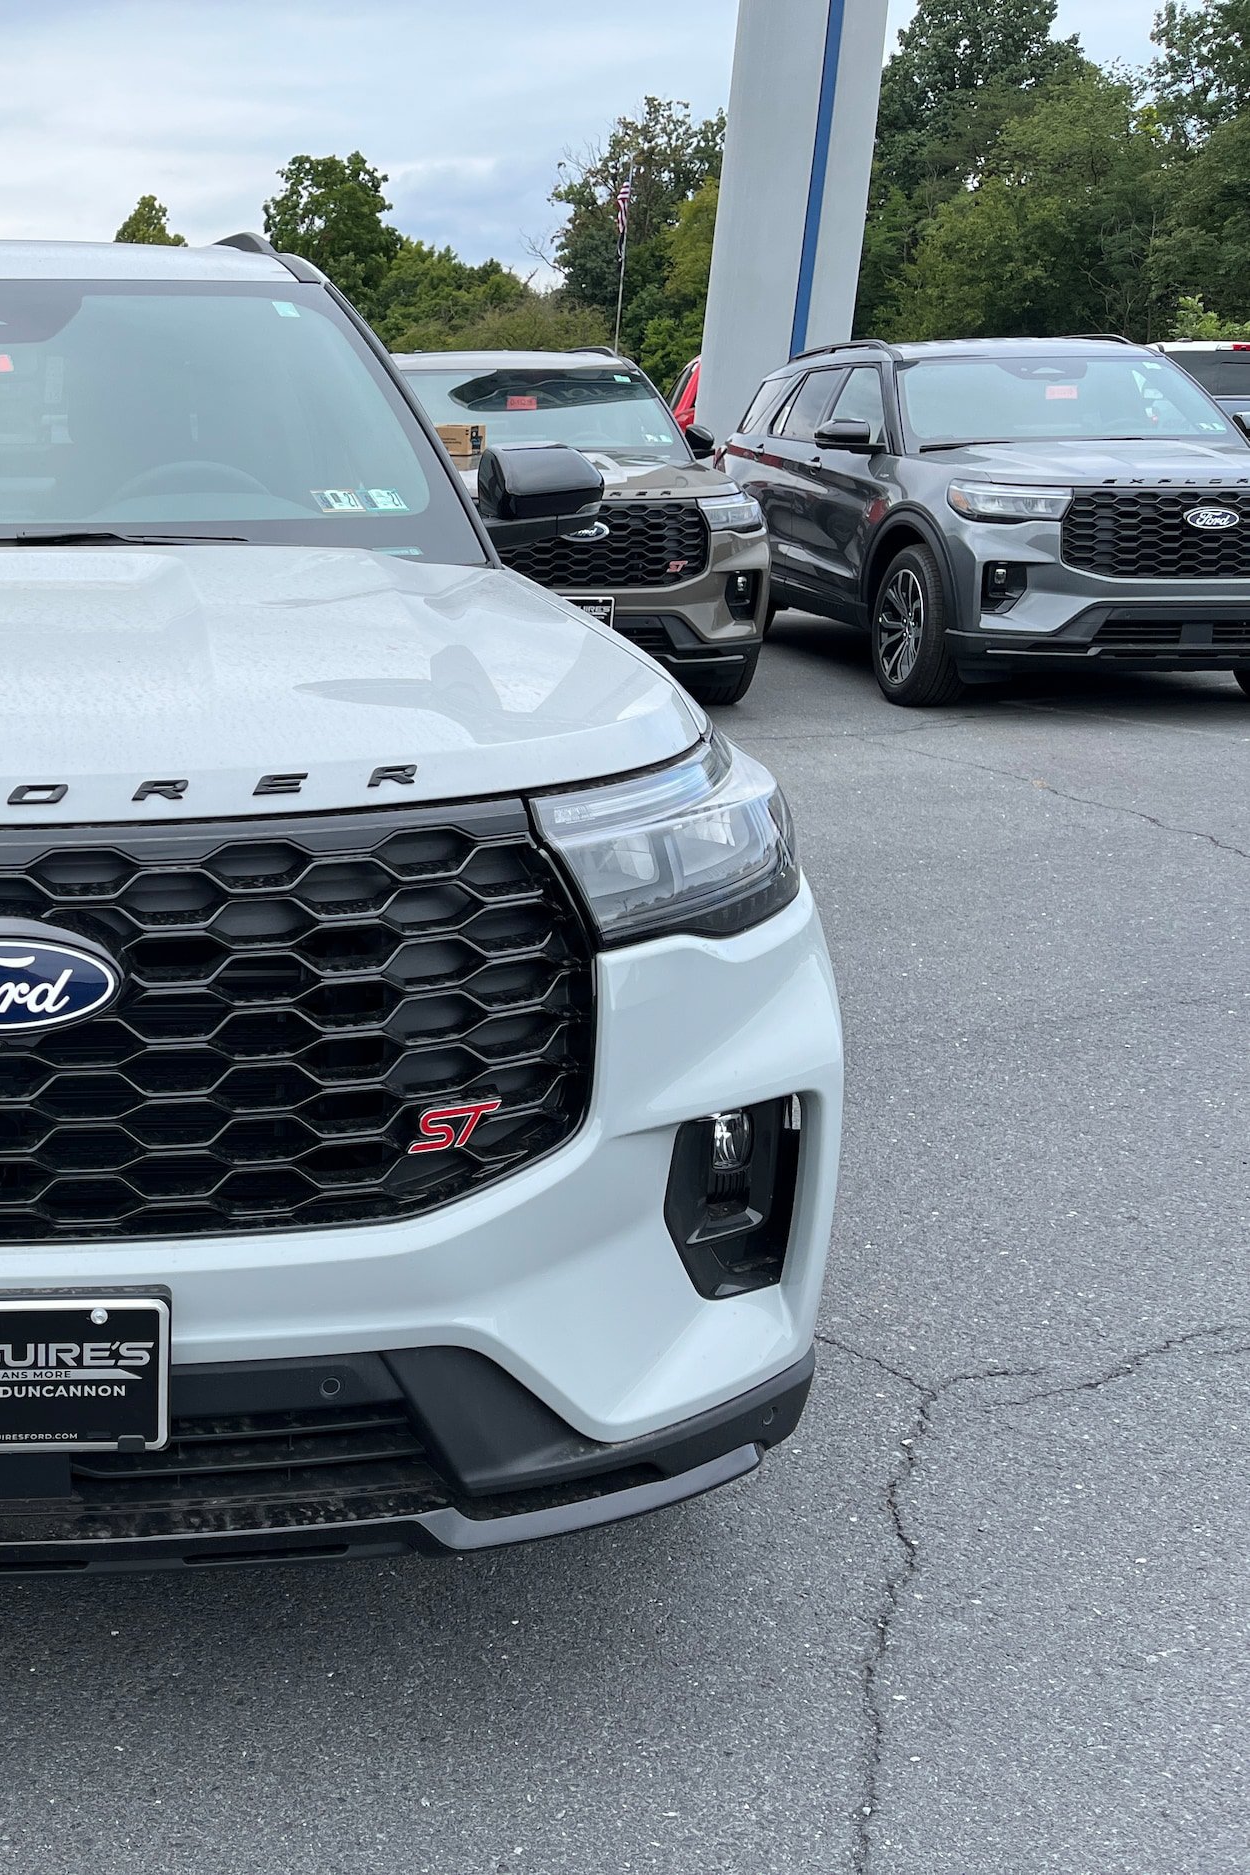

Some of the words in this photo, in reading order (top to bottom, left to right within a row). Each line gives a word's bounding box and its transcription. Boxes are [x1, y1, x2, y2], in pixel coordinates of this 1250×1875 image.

[1195, 511, 1230, 526] Ford
[667, 560, 688, 573] ST
[408, 1099, 502, 1154] ST
[33, 1370, 71, 1379] MORE
[0, 1385, 126, 1398] DUNCANNON
